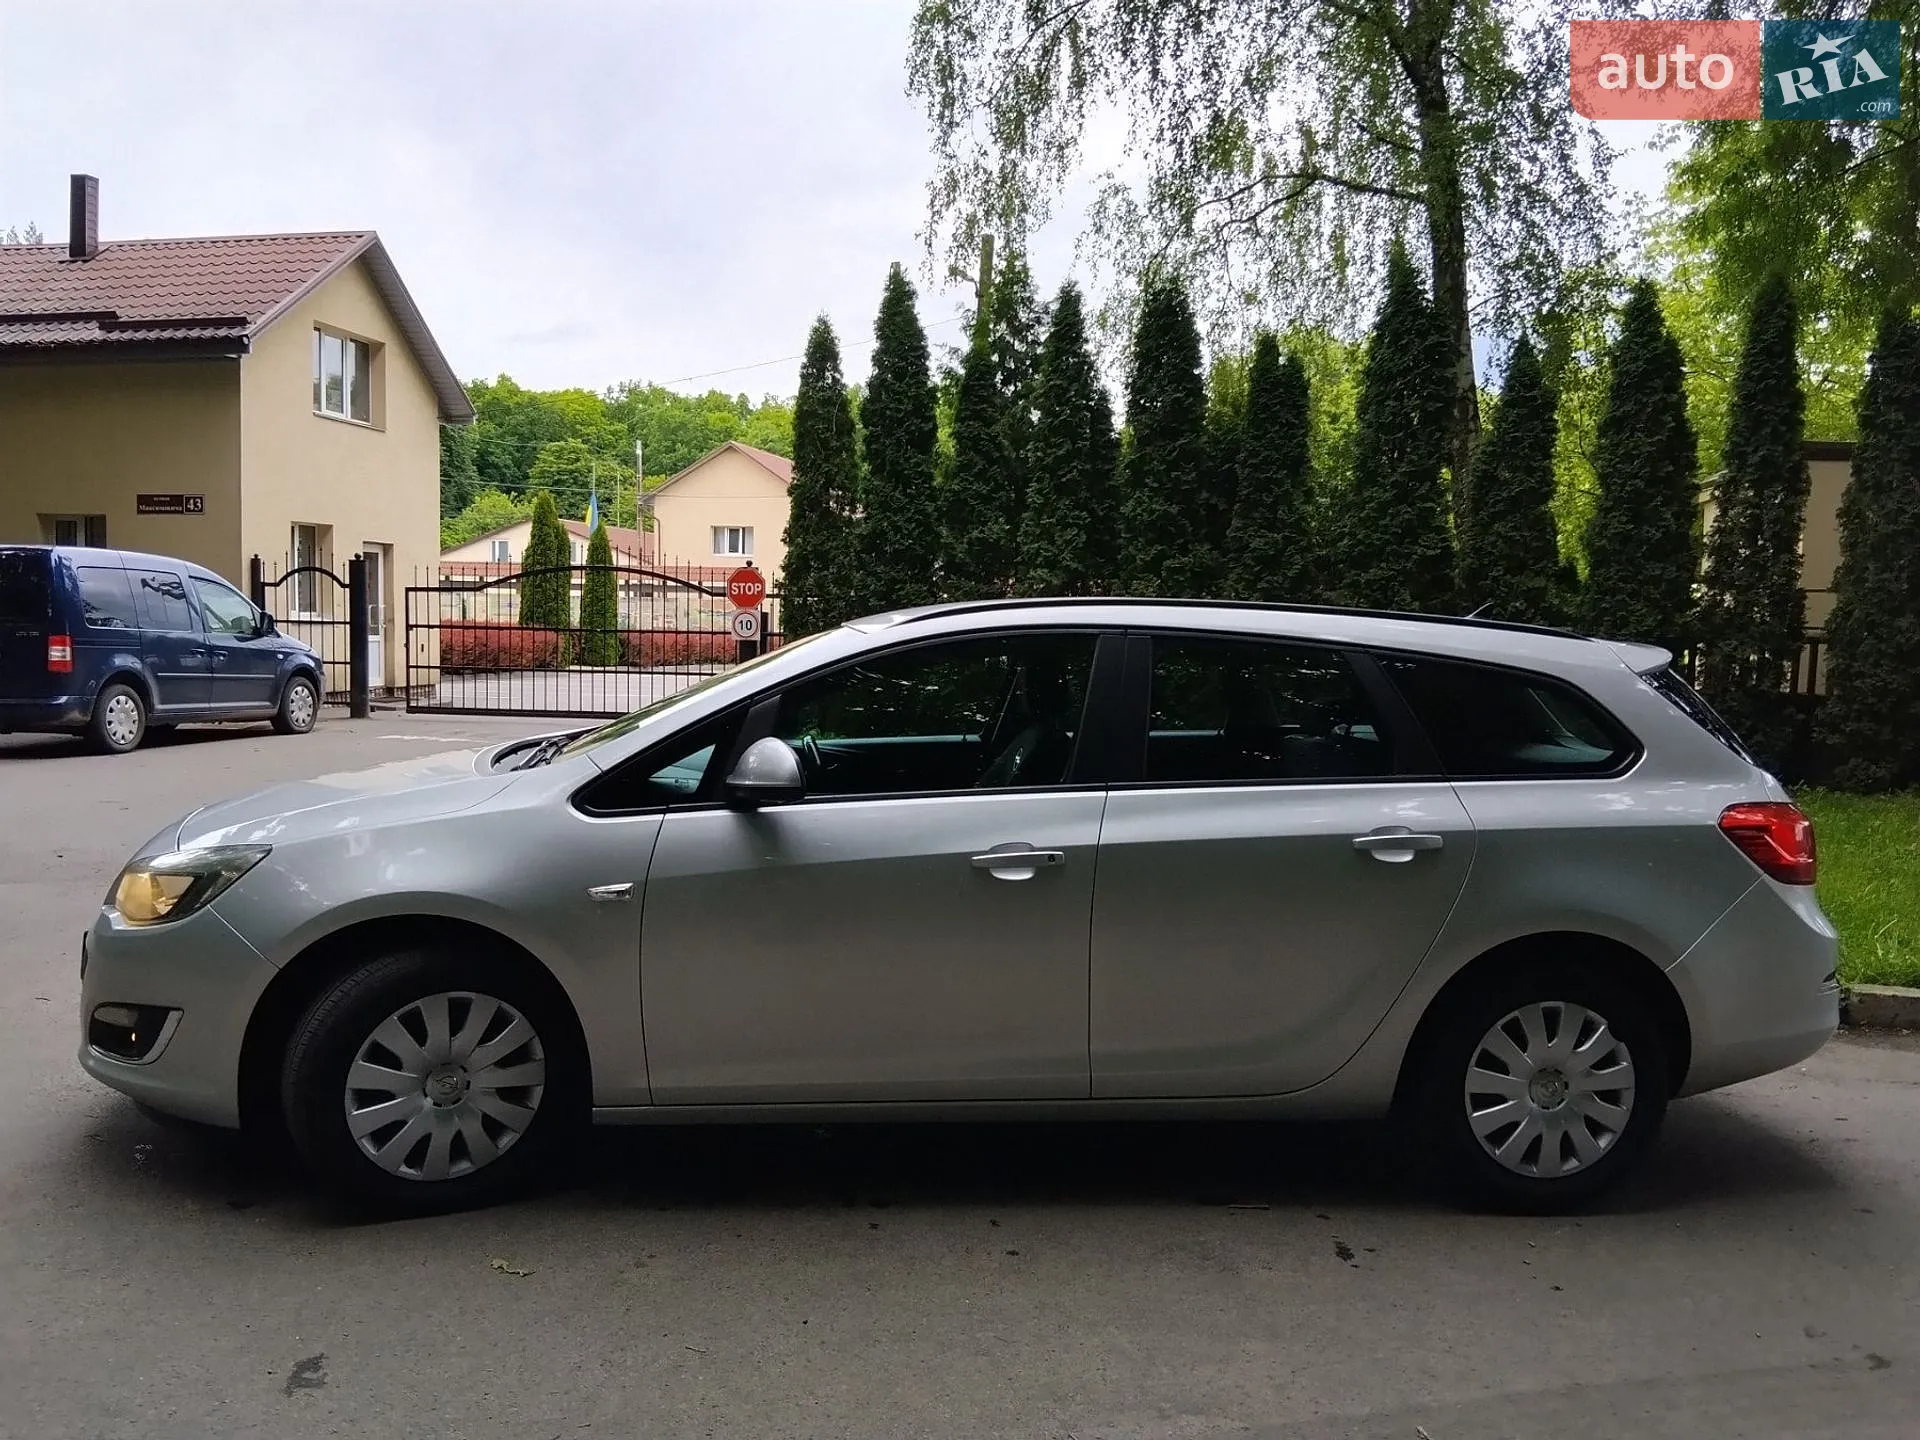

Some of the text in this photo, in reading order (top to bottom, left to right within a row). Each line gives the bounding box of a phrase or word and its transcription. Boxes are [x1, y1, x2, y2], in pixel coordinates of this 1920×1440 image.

[187, 498, 202, 511] 43
[731, 582, 762, 595] STOP
[739, 619, 753, 631] 10
